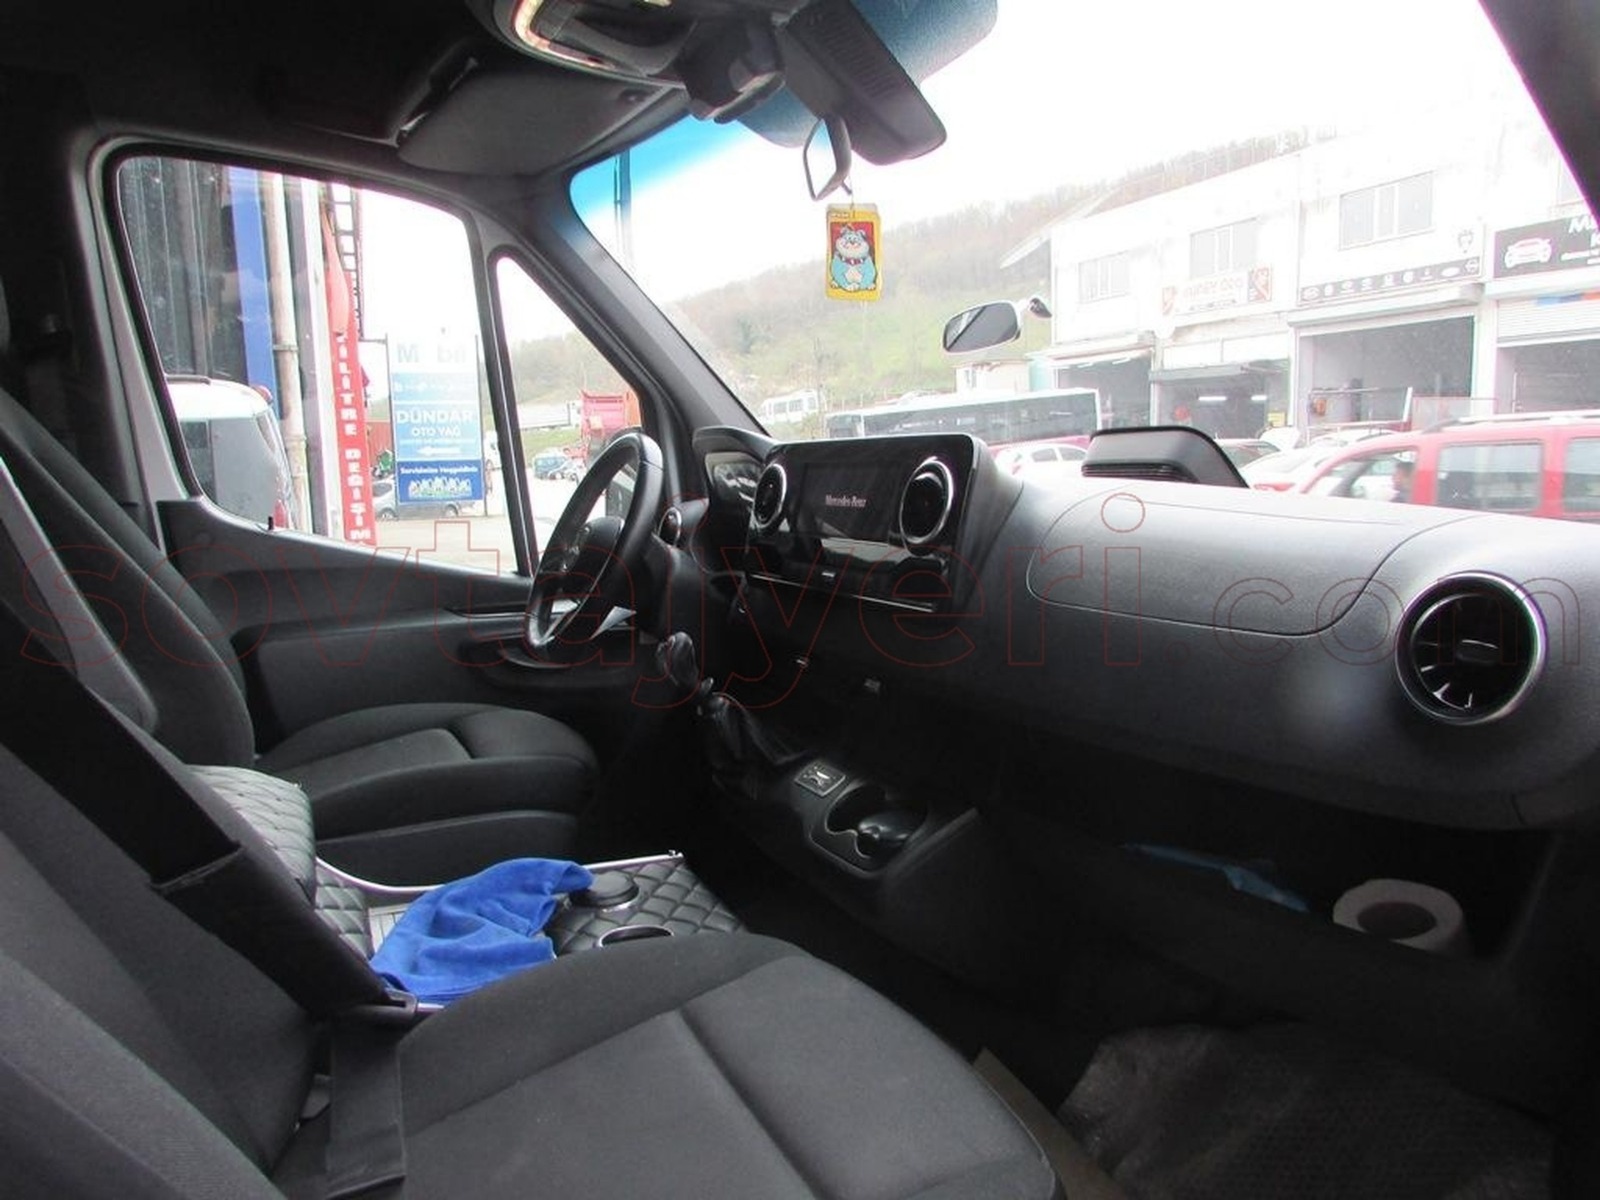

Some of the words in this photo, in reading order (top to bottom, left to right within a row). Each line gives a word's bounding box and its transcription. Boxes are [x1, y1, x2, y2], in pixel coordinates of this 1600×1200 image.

[397, 342, 466, 363] Mbil
[396, 407, 473, 424] DÜNDAR
[411, 427, 436, 437] OTO
